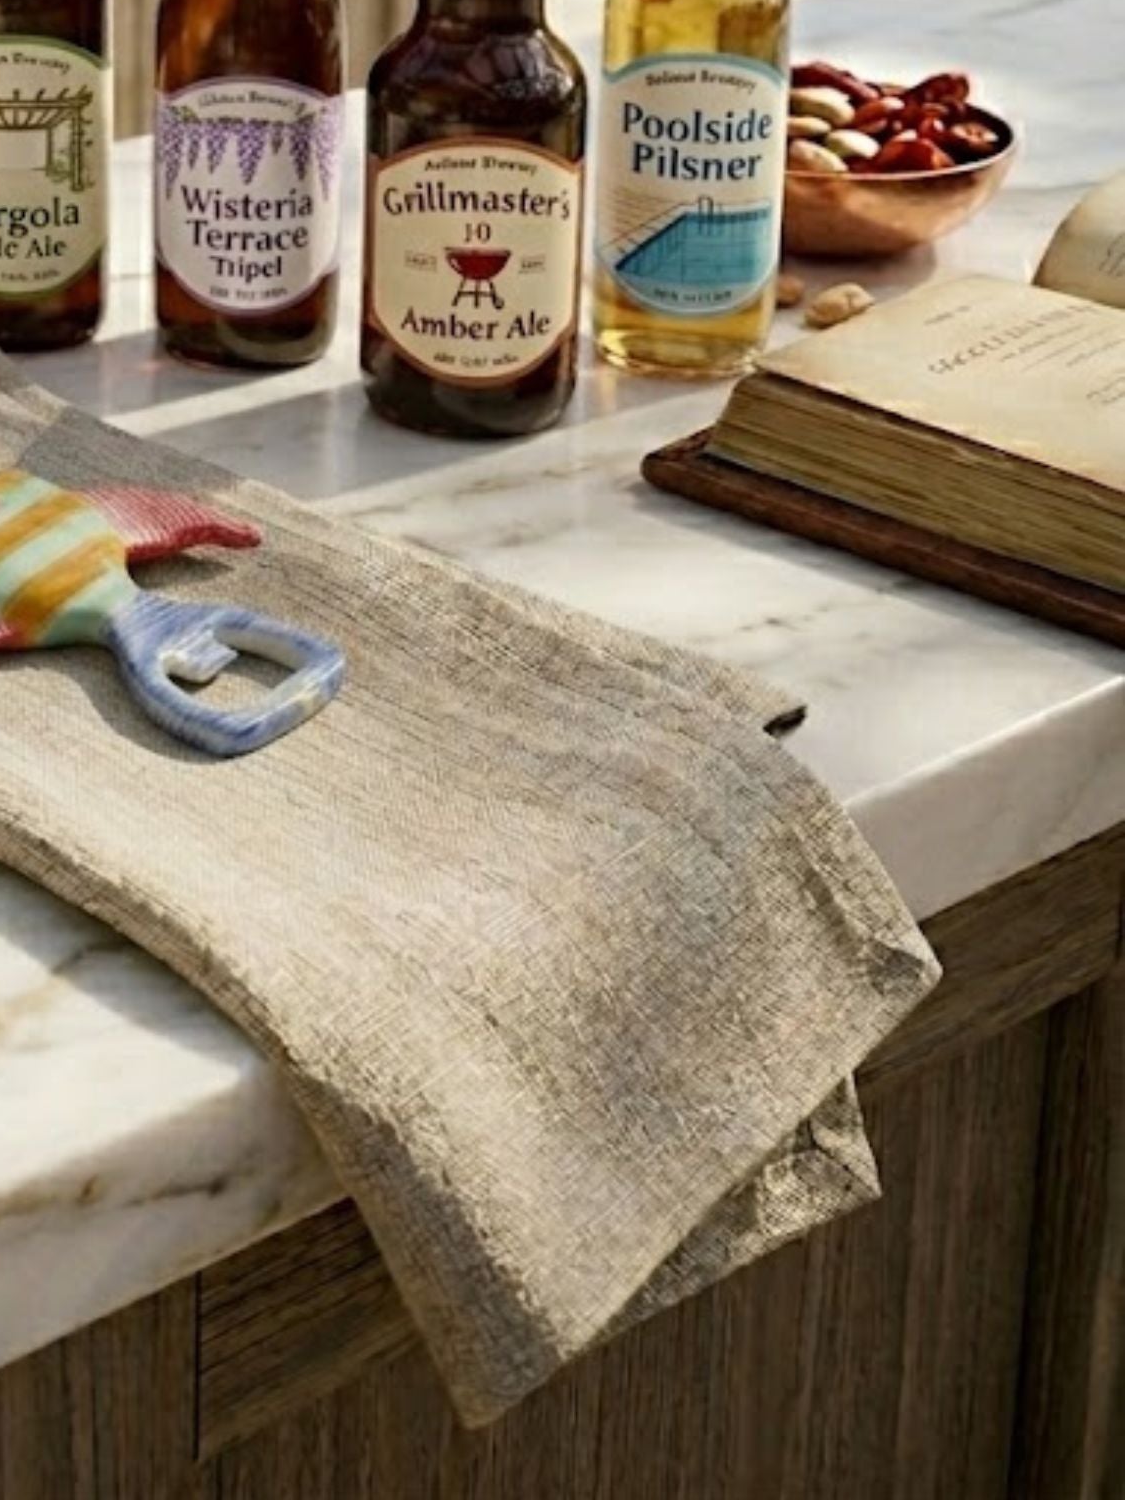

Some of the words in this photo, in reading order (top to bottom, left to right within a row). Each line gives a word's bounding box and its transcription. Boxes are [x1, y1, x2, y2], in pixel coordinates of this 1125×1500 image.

[622, 102, 772, 144] Poolside
[632, 143, 762, 181] Pilsner
[181, 184, 313, 221] Wisteria
[382, 181, 570, 220] Grillmaster's
[26, 235, 67, 259] Ale
[186, 219, 309, 251] Terrace
[401, 305, 499, 339] Amber
[506, 309, 551, 339] Ale
